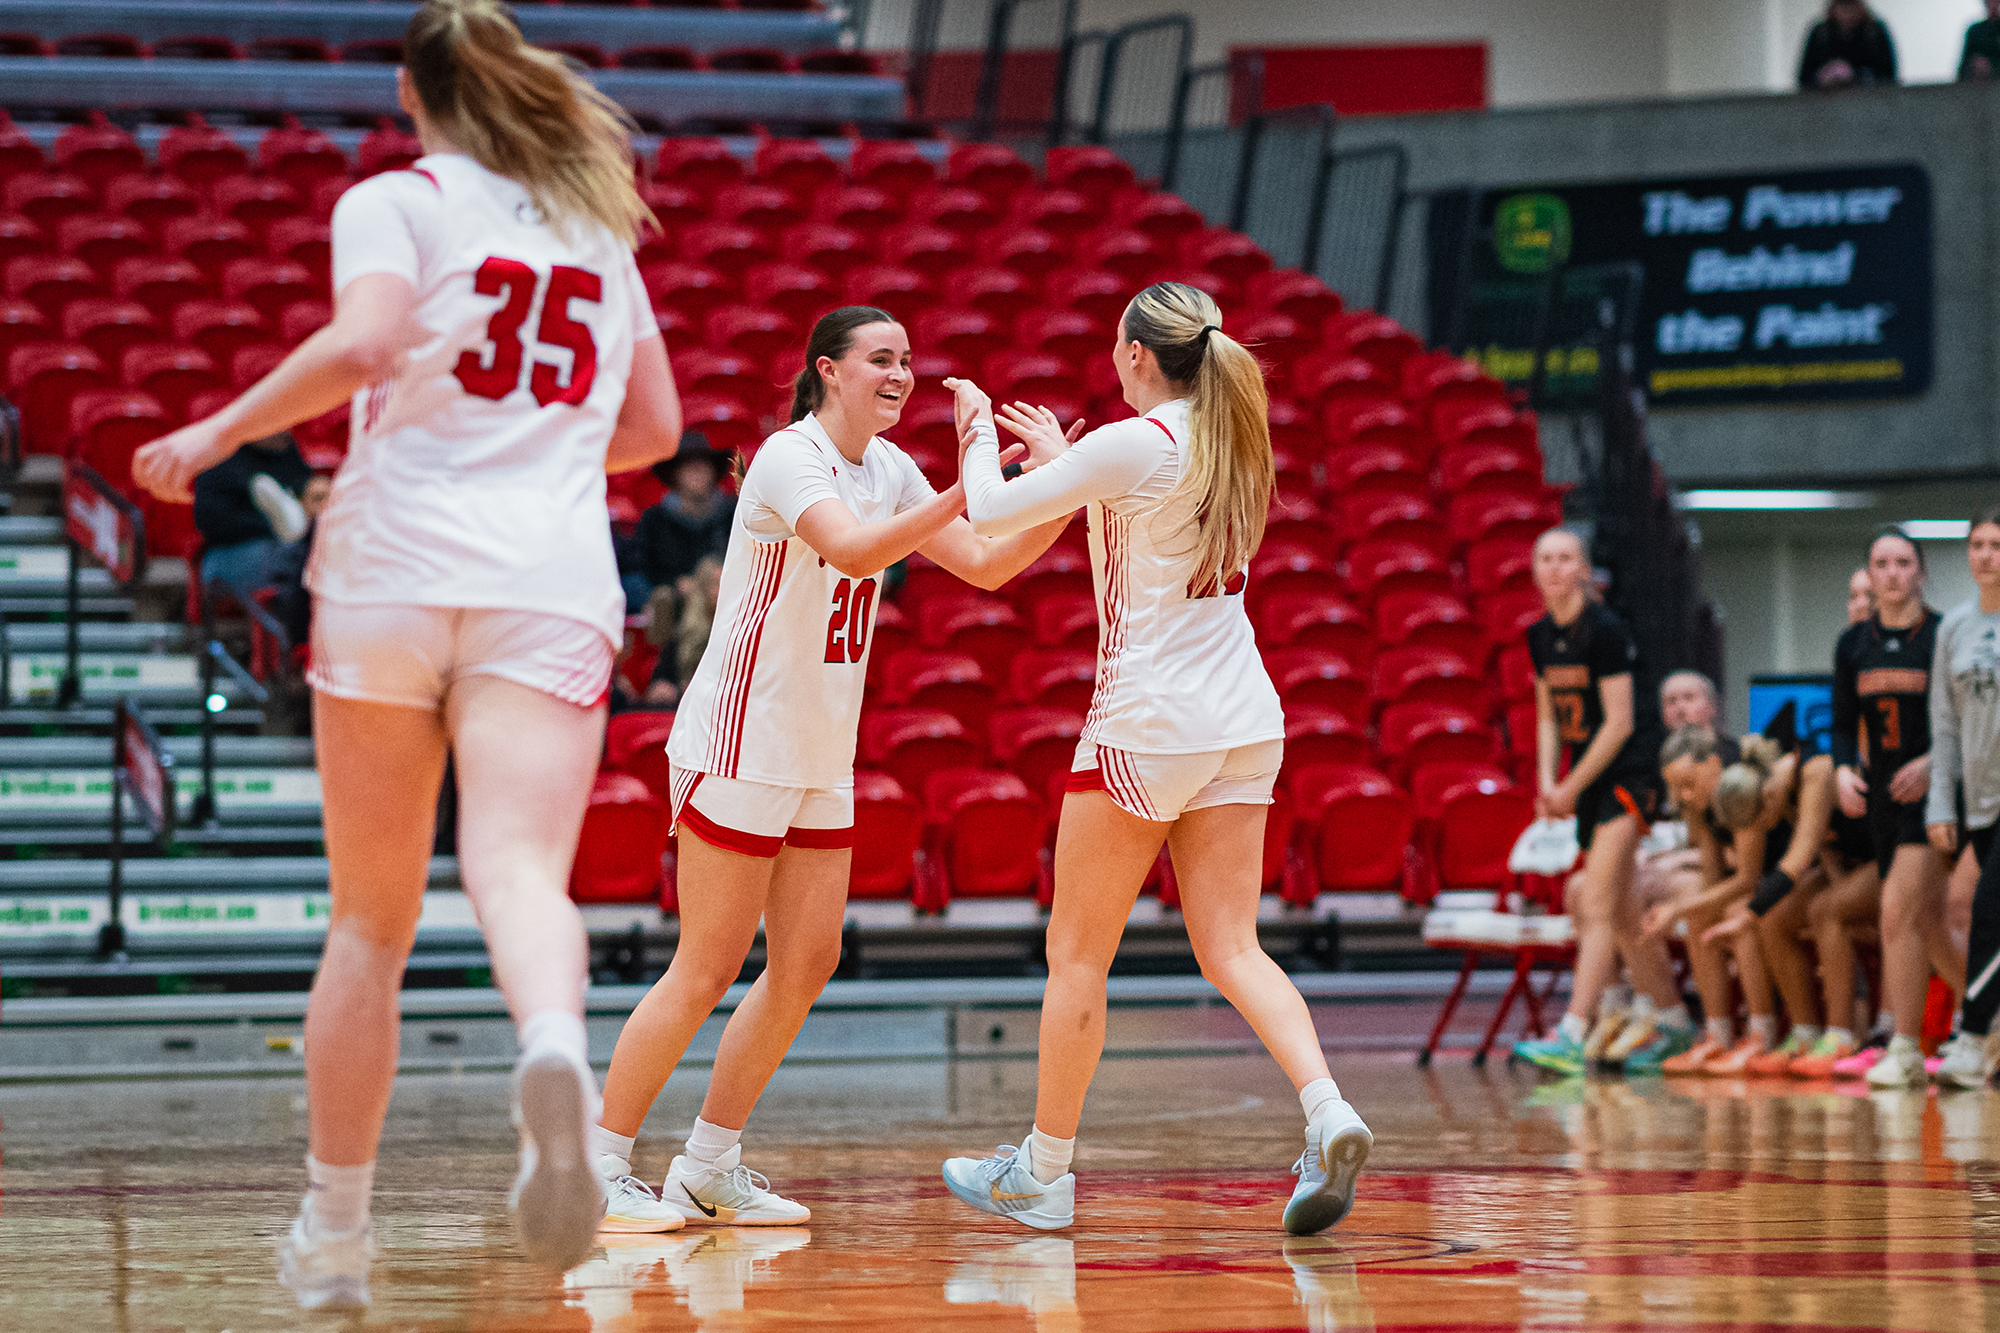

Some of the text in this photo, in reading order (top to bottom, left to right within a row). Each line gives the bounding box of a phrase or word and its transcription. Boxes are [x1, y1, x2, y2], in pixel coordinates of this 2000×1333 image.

[1644, 187, 1902, 235] The Power
[1686, 242, 1857, 293] Behind
[455, 256, 603, 407] 35
[1656, 304, 1892, 353] the Paint
[824, 578, 877, 663] 20
[1877, 697, 1901, 749] 3
